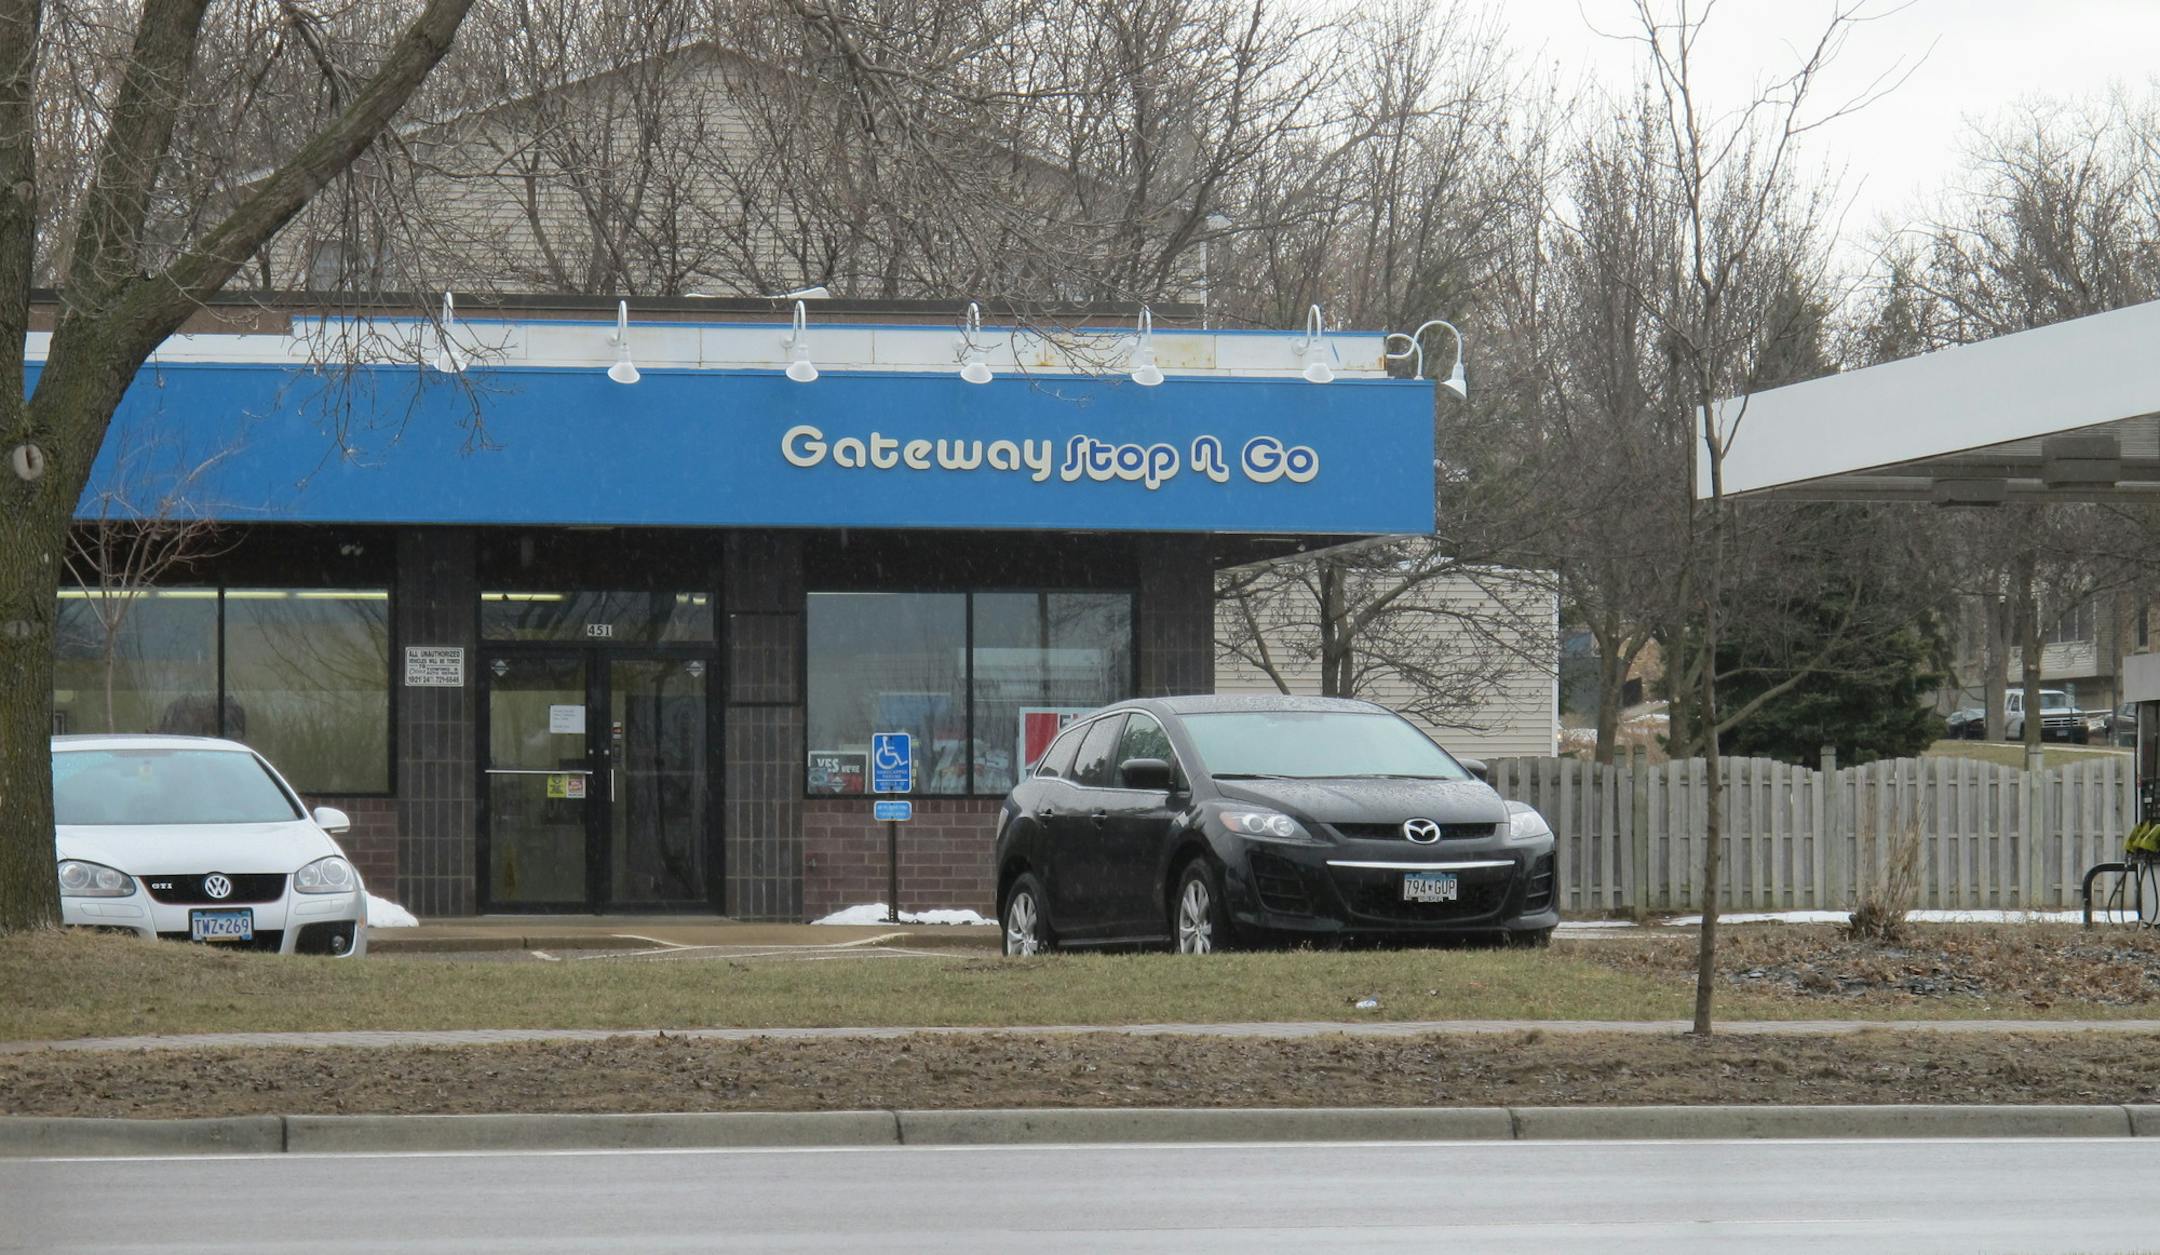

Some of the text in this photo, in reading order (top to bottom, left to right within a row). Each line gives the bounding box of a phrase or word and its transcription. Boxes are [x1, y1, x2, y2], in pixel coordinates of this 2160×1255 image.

[781, 424, 1052, 482] Gateway
[1060, 433, 1180, 490] Stop
[1241, 435, 1320, 483] Go
[588, 625, 609, 636] 451
[816, 758, 840, 774] YES
